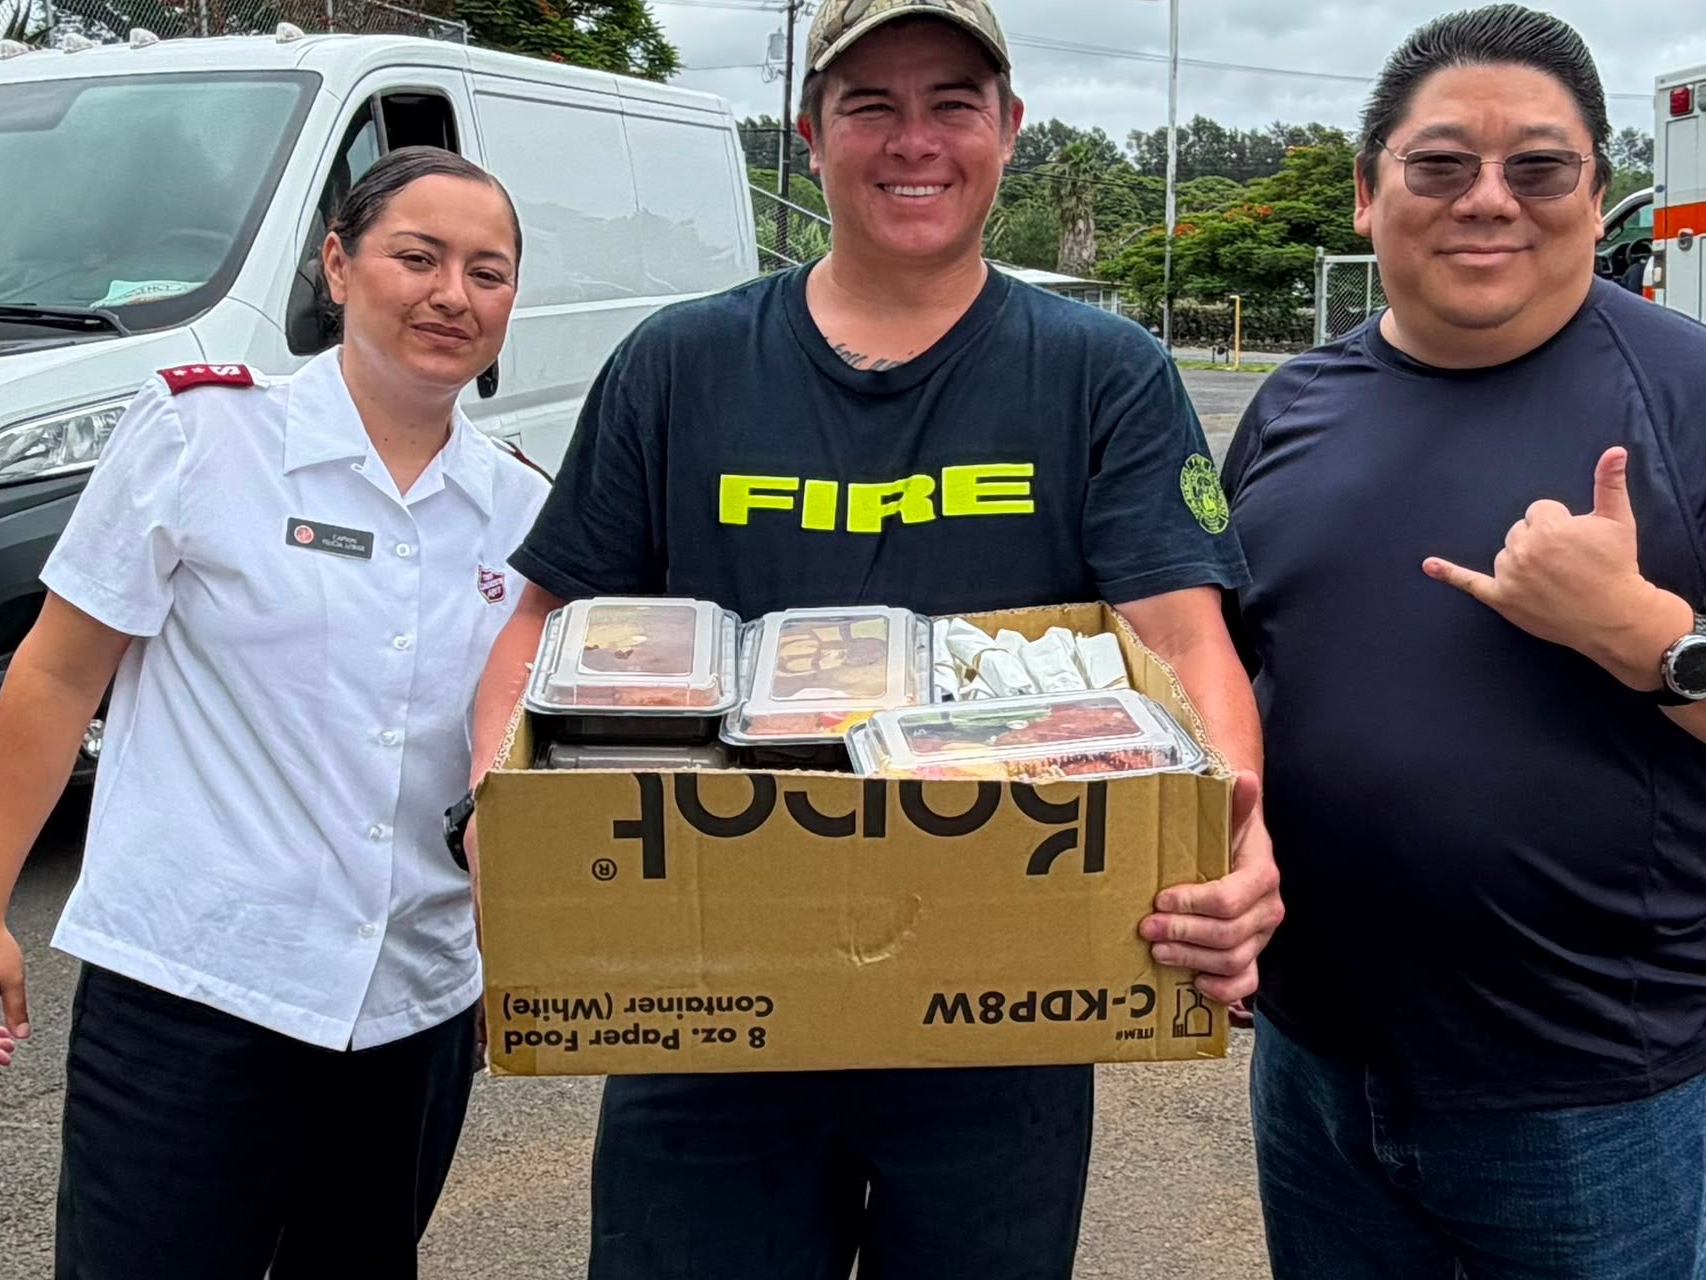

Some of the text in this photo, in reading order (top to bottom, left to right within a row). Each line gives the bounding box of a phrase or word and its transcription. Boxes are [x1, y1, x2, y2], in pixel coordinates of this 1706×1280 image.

[718, 462, 1035, 534] FIRE
[502, 992, 774, 1021] Container (White)
[922, 984, 1156, 1025] C-KDP8W
[504, 1023, 766, 1054] 8 oz. Paper Food
